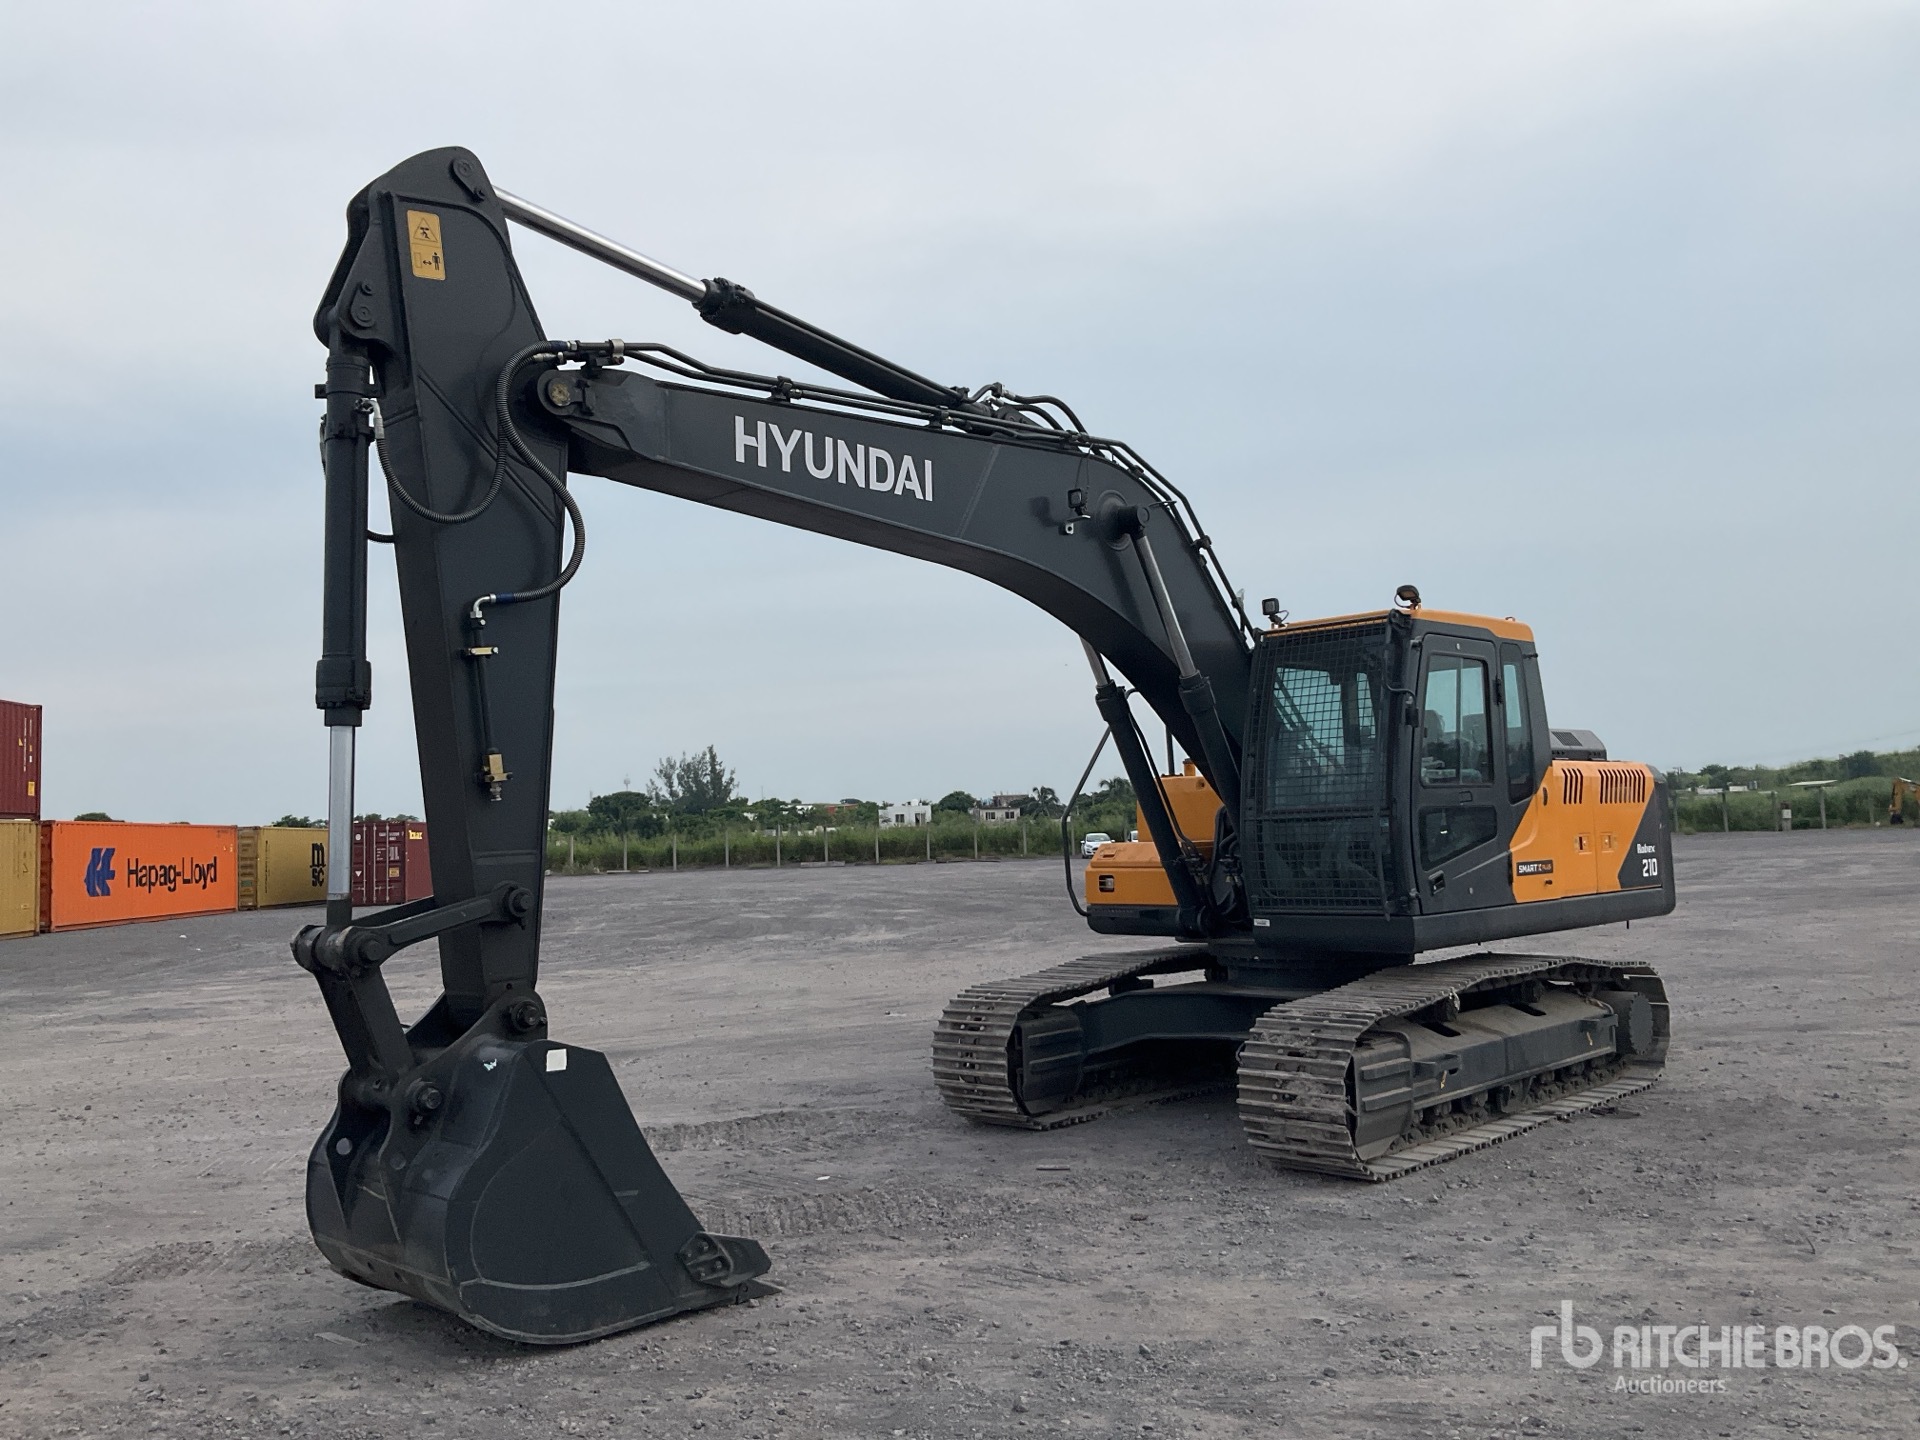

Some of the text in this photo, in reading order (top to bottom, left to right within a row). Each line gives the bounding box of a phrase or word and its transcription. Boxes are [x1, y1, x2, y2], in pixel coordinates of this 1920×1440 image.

[734, 415, 933, 502] HYUNDAI
[127, 856, 217, 894] Hapag-Lloyd
[1518, 864, 1538, 874] SMART
[1642, 858, 1658, 877] 210
